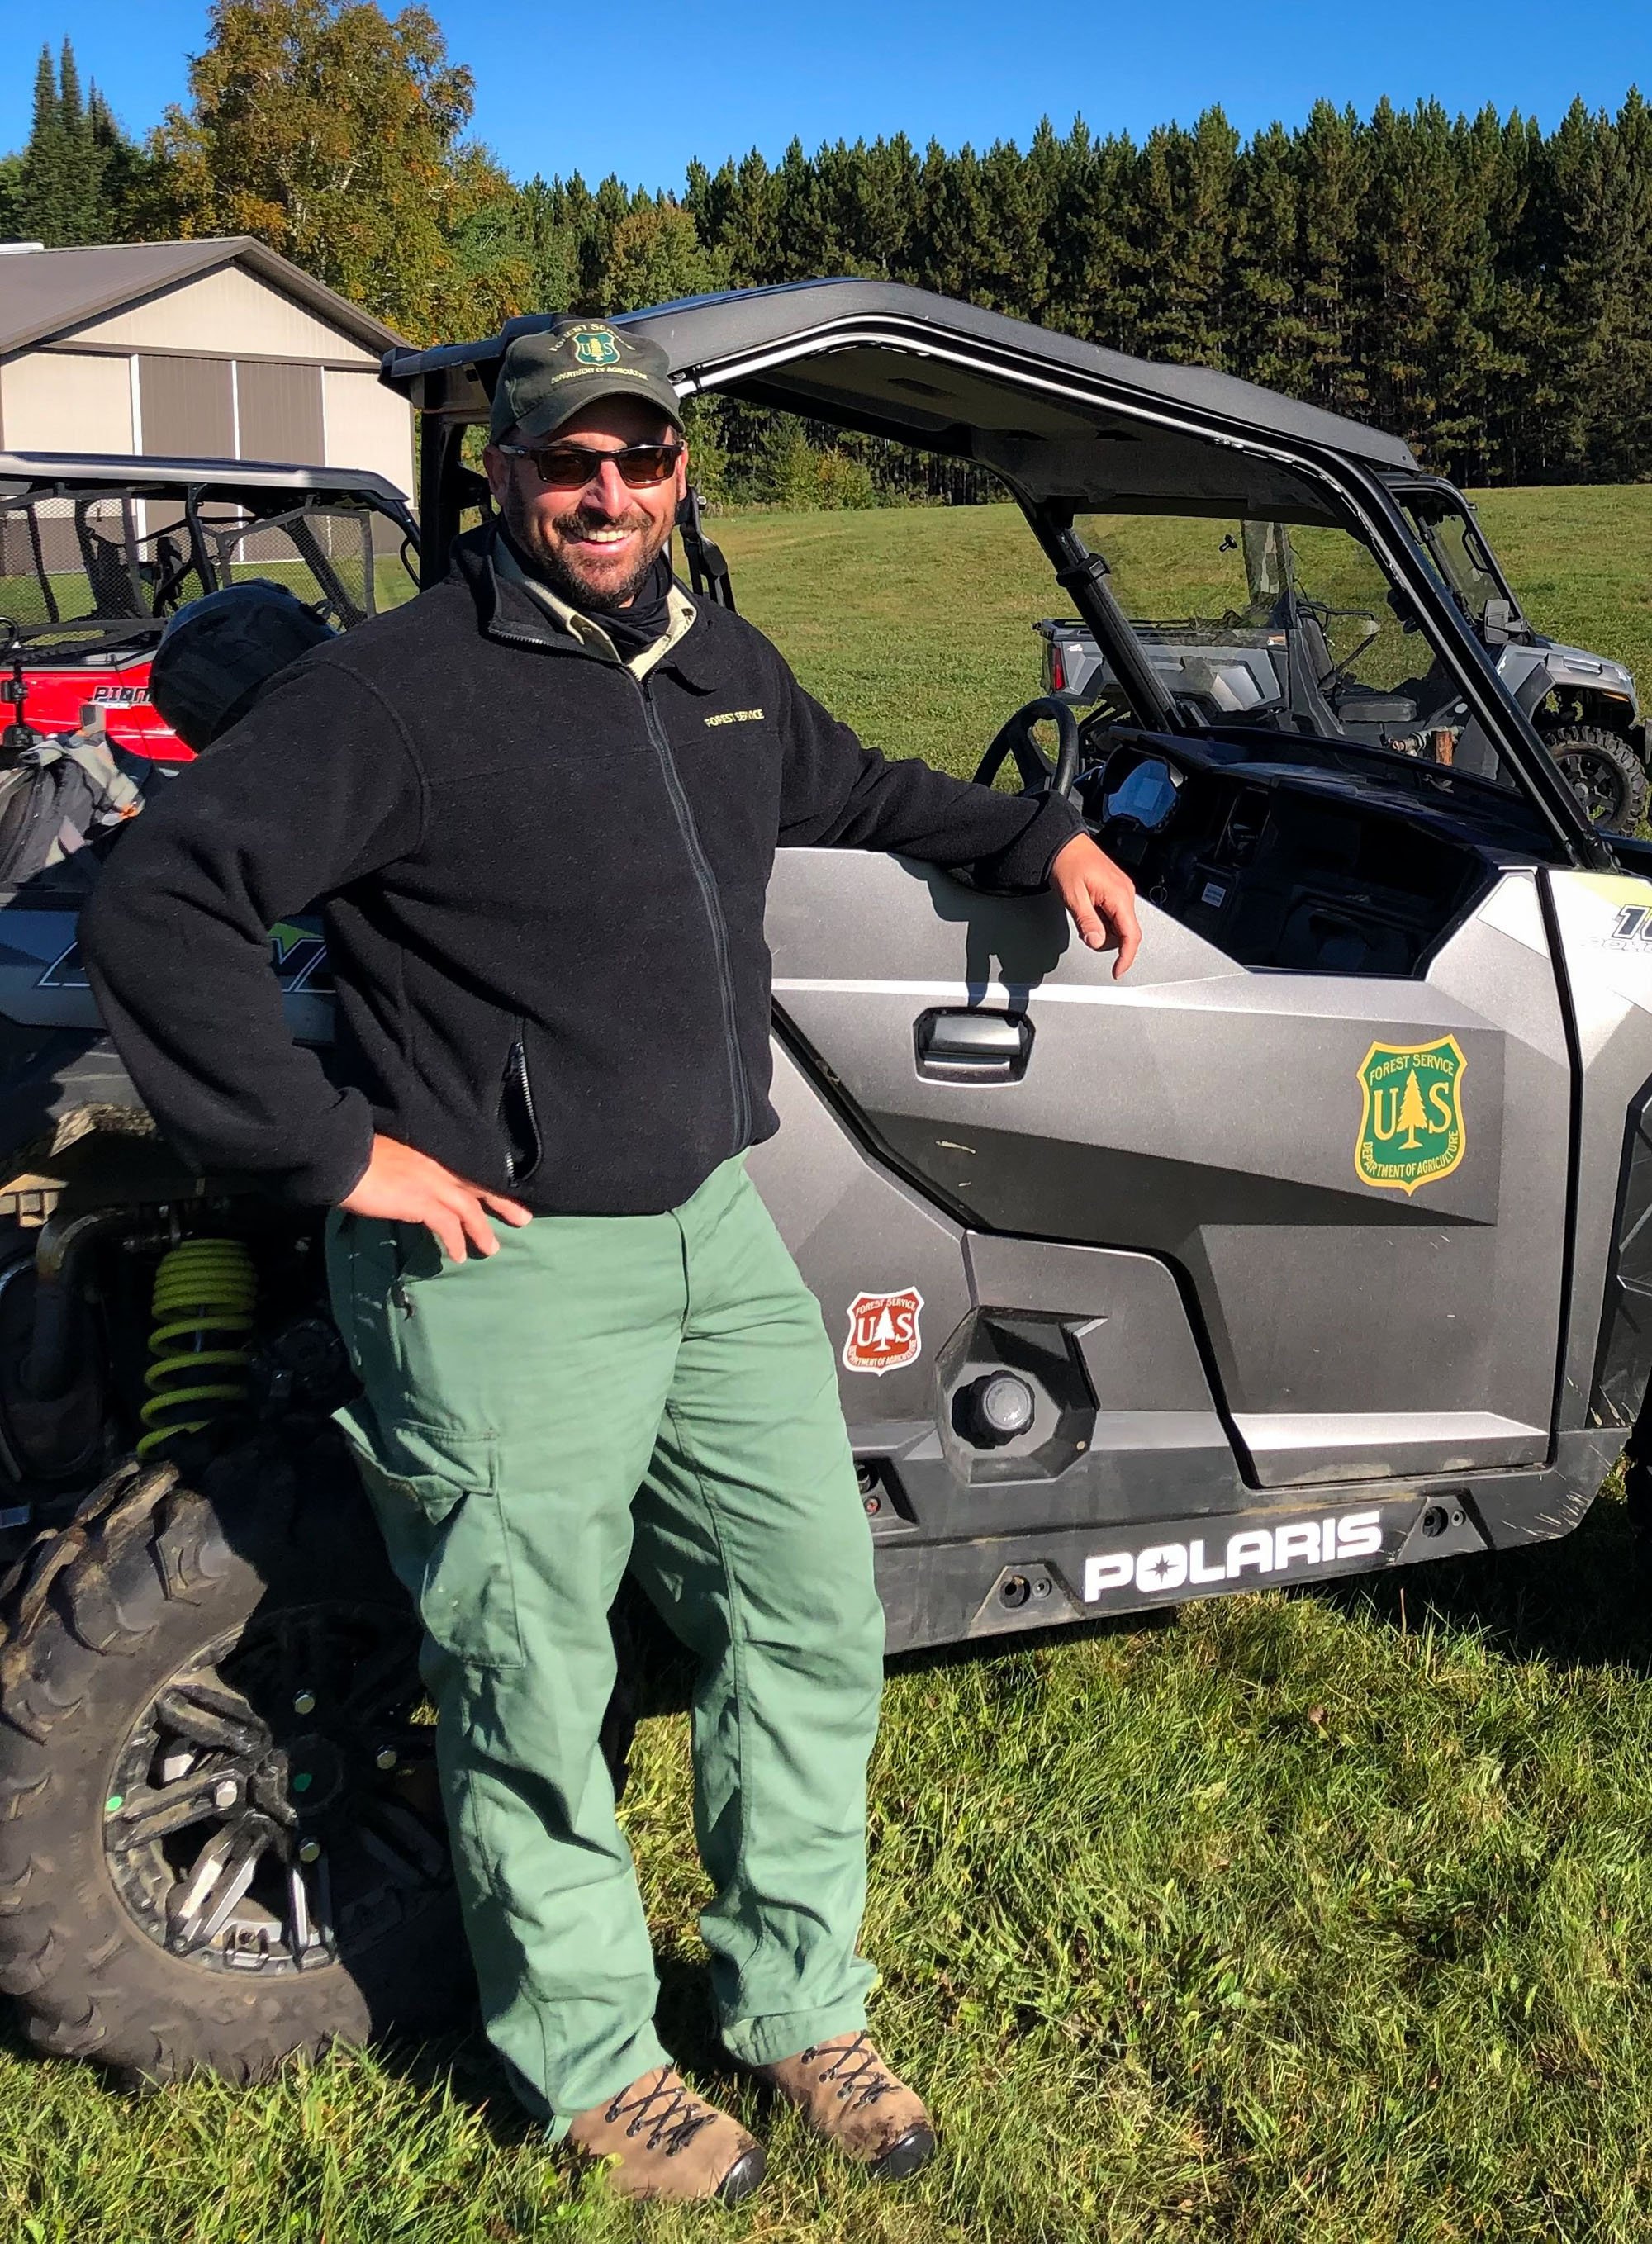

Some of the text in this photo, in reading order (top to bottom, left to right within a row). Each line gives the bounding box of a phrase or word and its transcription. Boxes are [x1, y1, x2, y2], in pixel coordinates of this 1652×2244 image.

[704, 709, 764, 727] FOREST SERVICE
[1370, 1054, 1455, 1086] FOREST SERVICE
[1363, 1130, 1458, 1178] DEPARTMENT OF AGRICULTURE
[856, 1298, 916, 1317] FOREST SERVICE
[877, 1357, 886, 1366] OF
[1084, 1511, 1382, 1603] POLARIS
